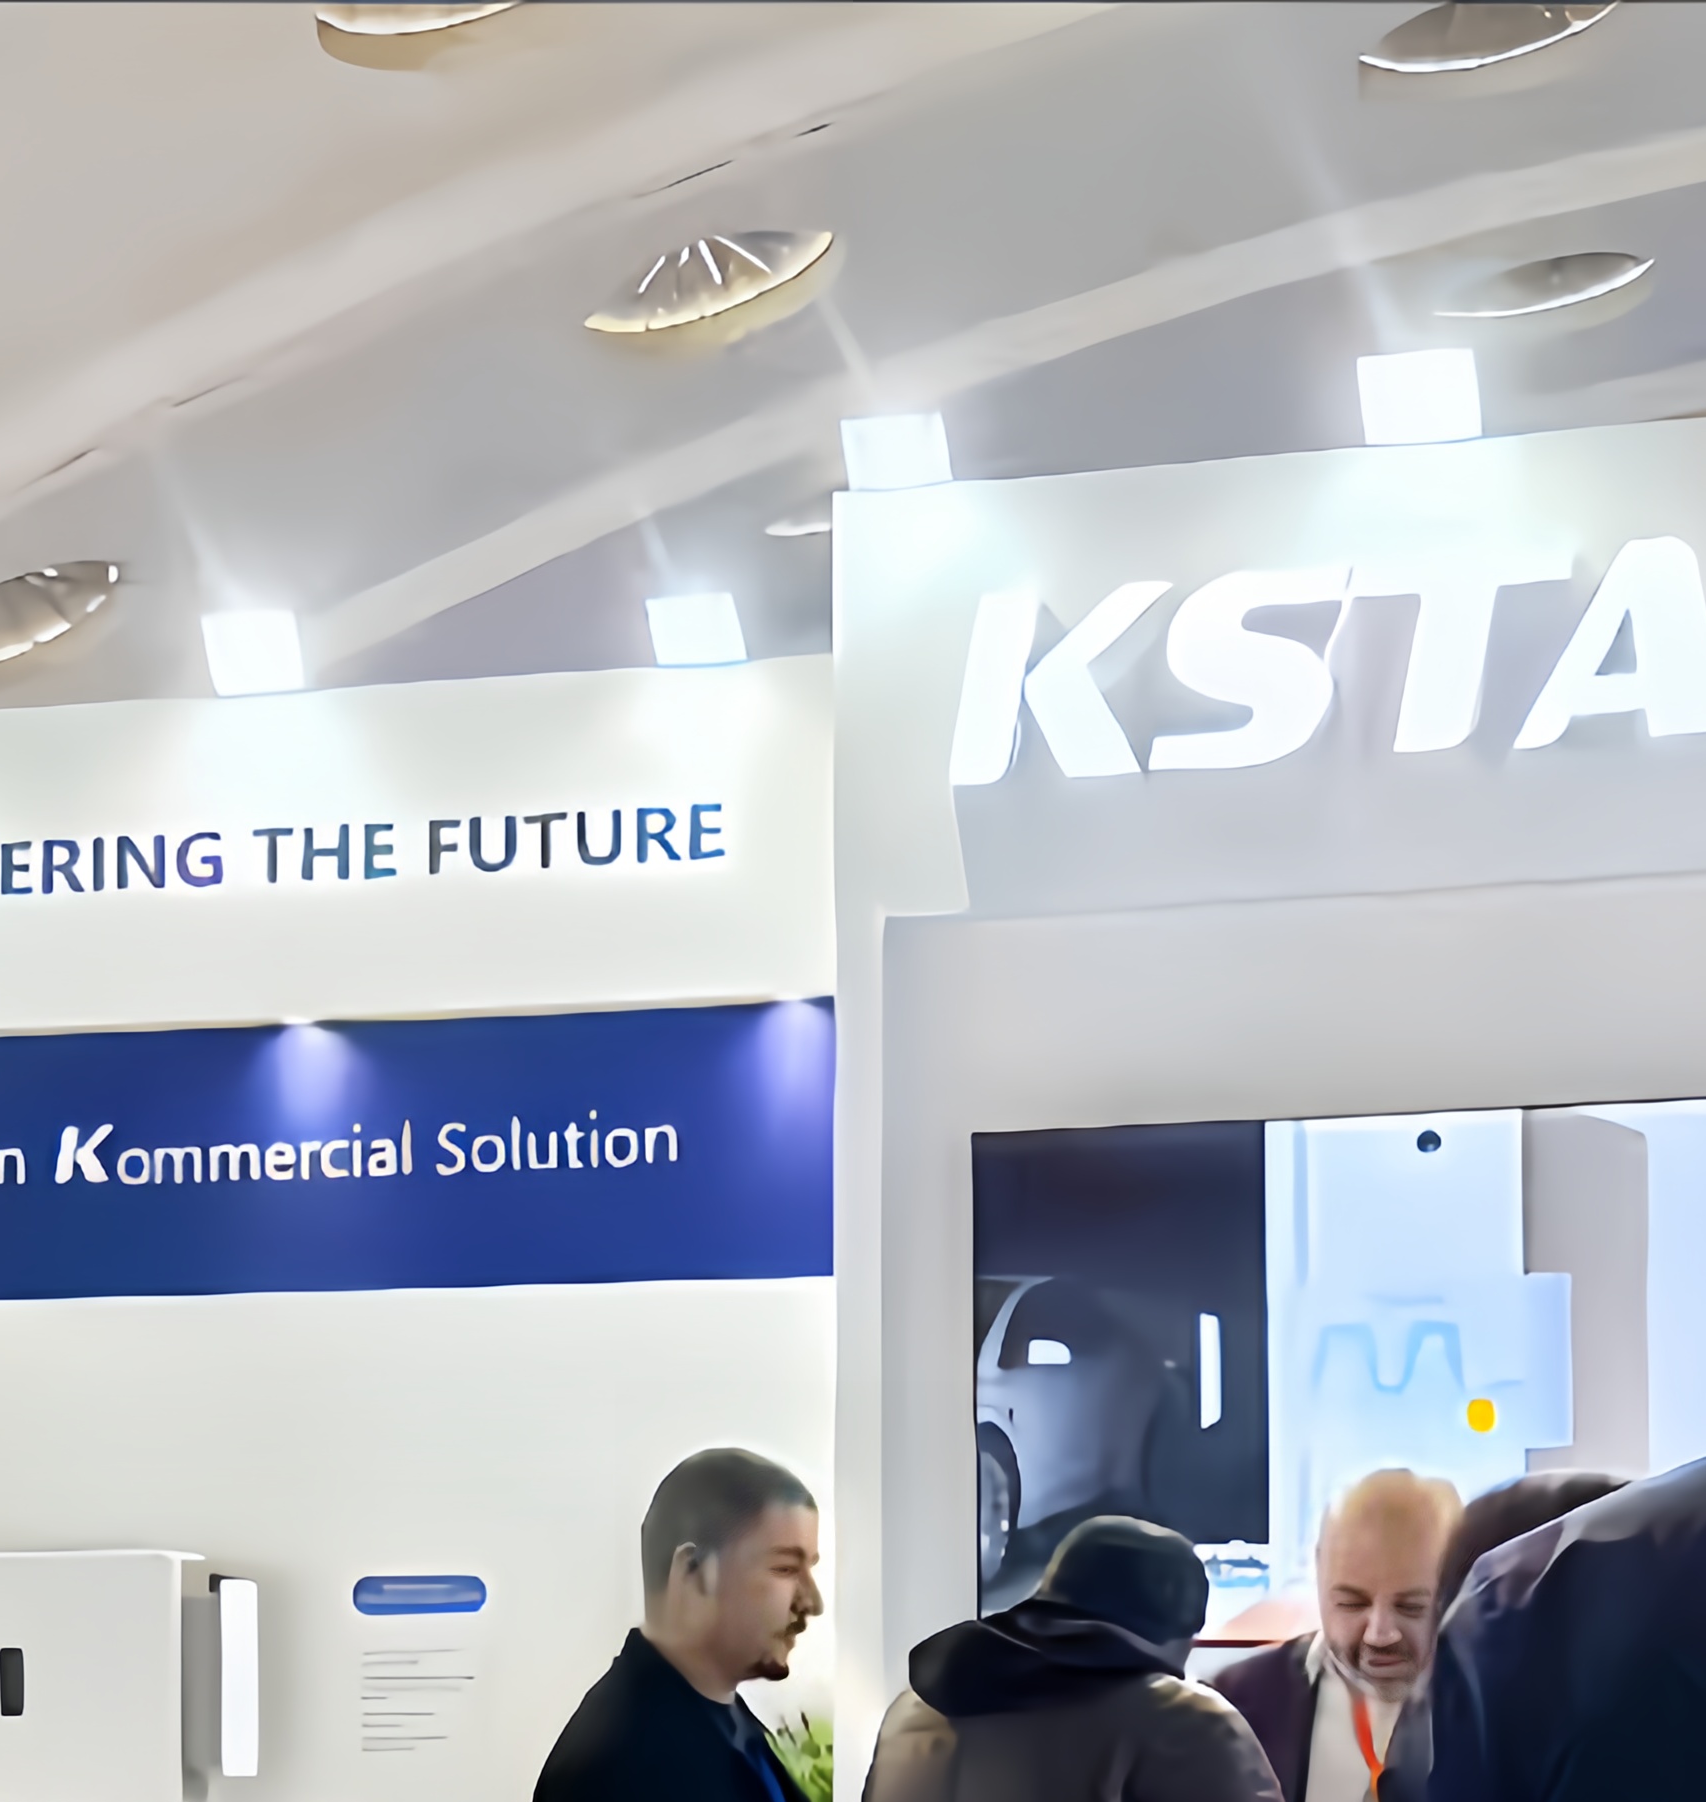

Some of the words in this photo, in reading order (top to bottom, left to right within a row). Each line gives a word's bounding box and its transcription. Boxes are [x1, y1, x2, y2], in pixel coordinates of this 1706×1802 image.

[252, 823, 398, 885] THE
[427, 802, 726, 877] FUTURE
[54, 1120, 414, 1186] Kommercial
[435, 1109, 680, 1176] Solution
